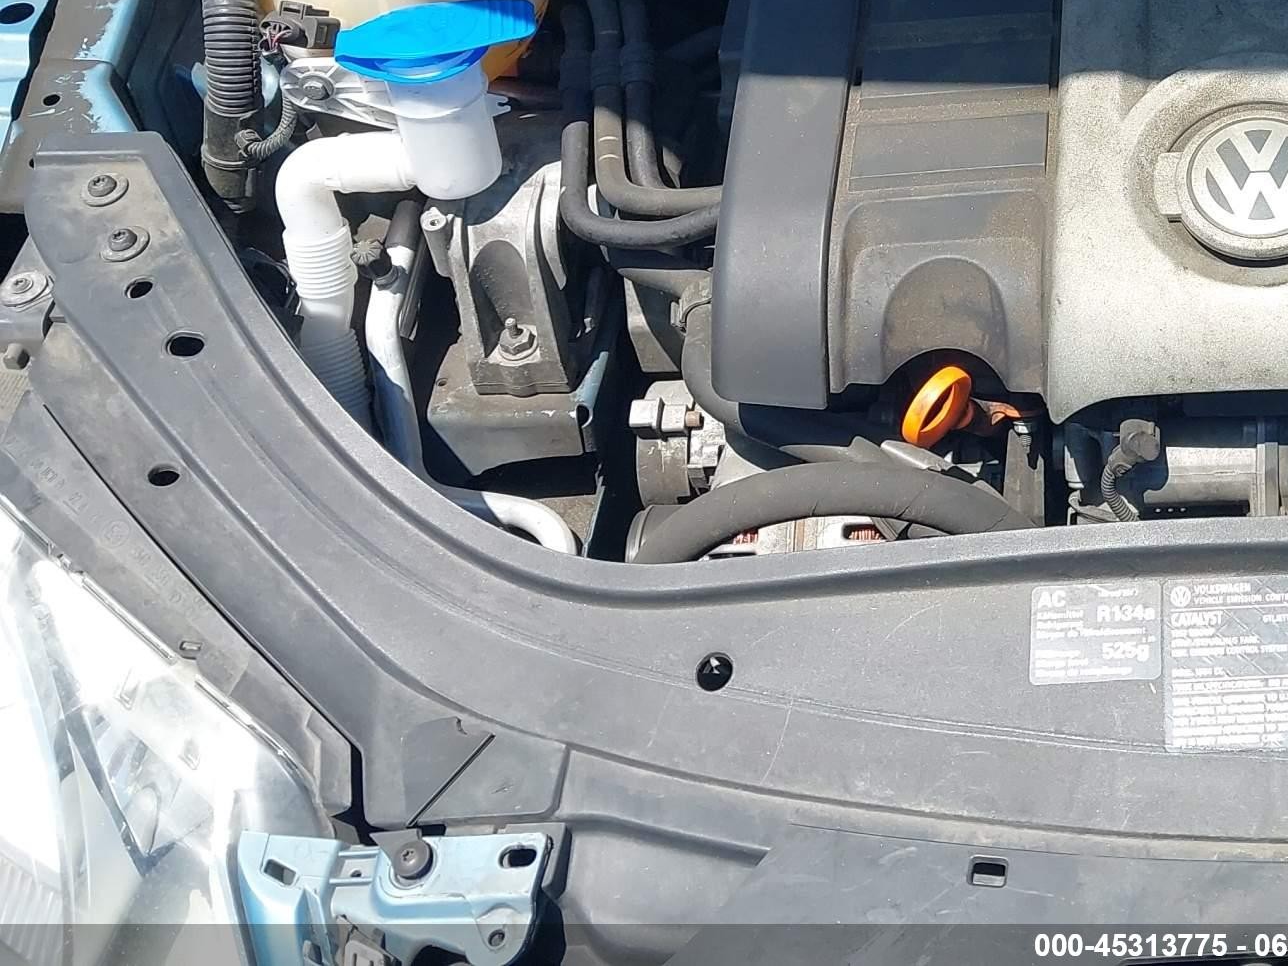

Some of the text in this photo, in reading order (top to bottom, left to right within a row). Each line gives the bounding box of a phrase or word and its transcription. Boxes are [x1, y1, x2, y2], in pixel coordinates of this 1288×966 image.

[1194, 583, 1251, 594] VOLKSWAGEN
[1038, 590, 1066, 608] AC
[1194, 594, 1224, 604] VEHICLE
[1227, 593, 1261, 603] EMISSION
[1096, 604, 1155, 622] R134a
[1171, 611, 1223, 627] CATALYST
[1102, 642, 1149, 662] 525g
